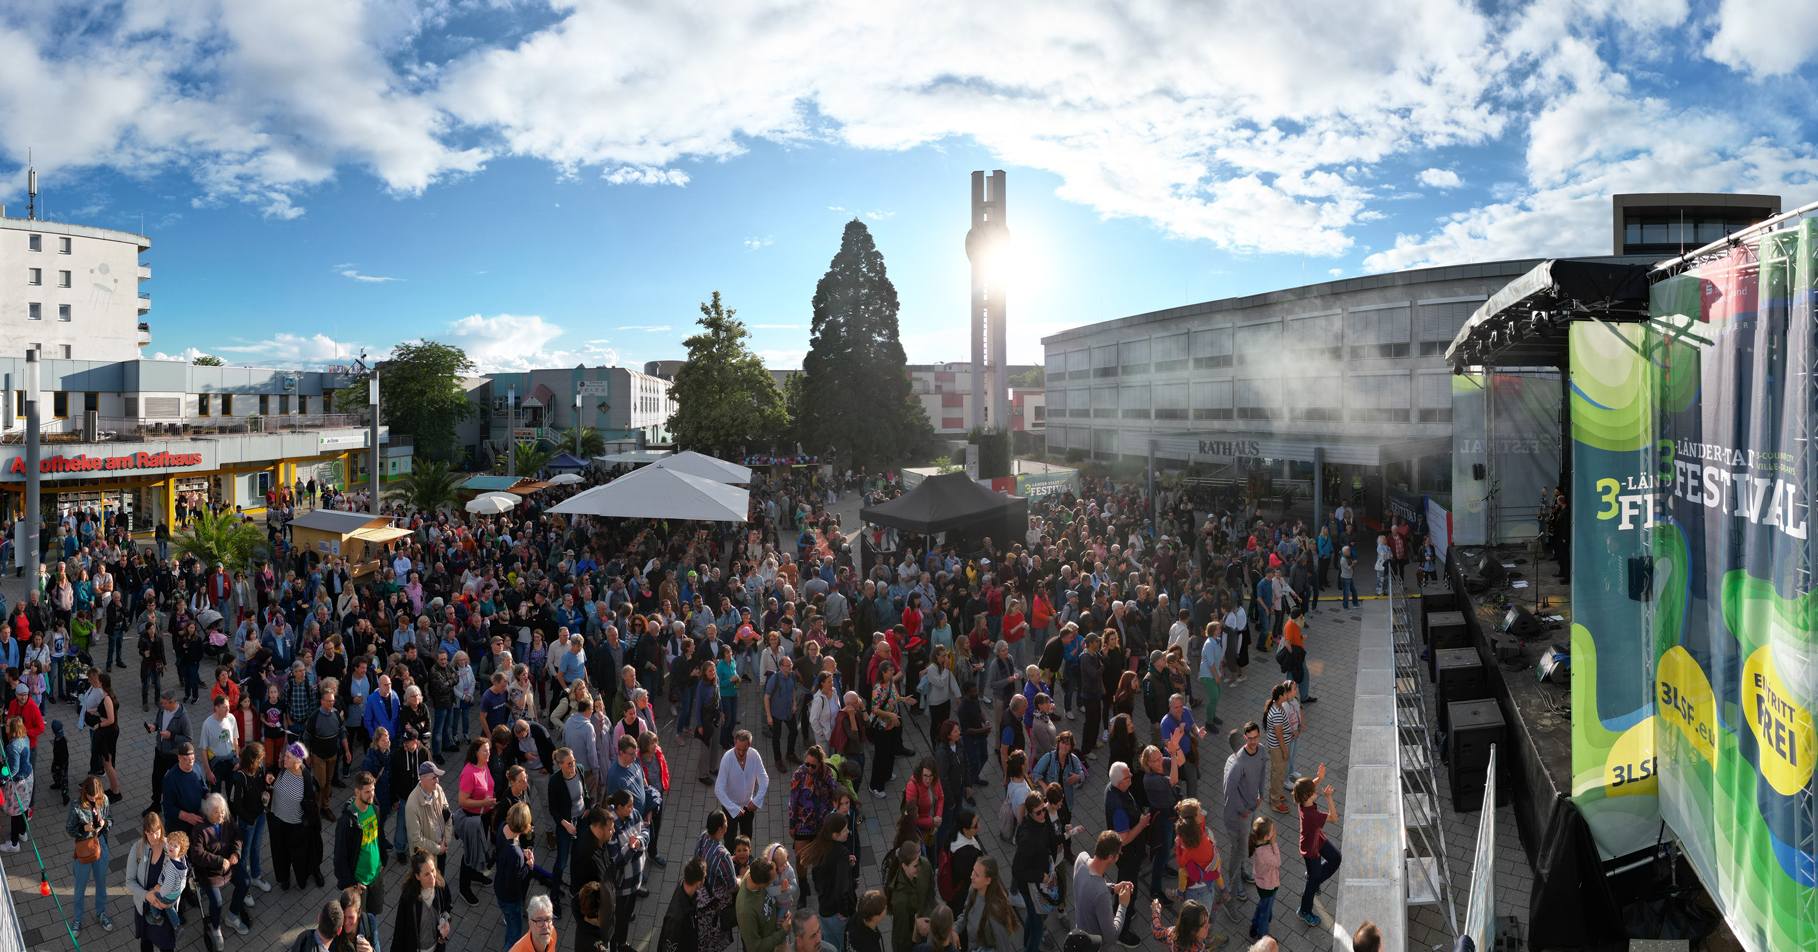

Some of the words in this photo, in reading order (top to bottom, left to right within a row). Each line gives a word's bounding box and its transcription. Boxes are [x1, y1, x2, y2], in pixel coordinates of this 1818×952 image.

[11, 453, 102, 474] Aotheke
[105, 456, 134, 470] am
[136, 450, 202, 469] Rathaus
[1199, 440, 1260, 456] RATHAUS
[1031, 483, 1074, 497] FESTIVAL
[1674, 459, 1807, 540] FESTIVAL
[1661, 681, 1715, 748] 3LSF.eu
[1754, 672, 1796, 723] EITRITT
[1756, 693, 1797, 767] FREI
